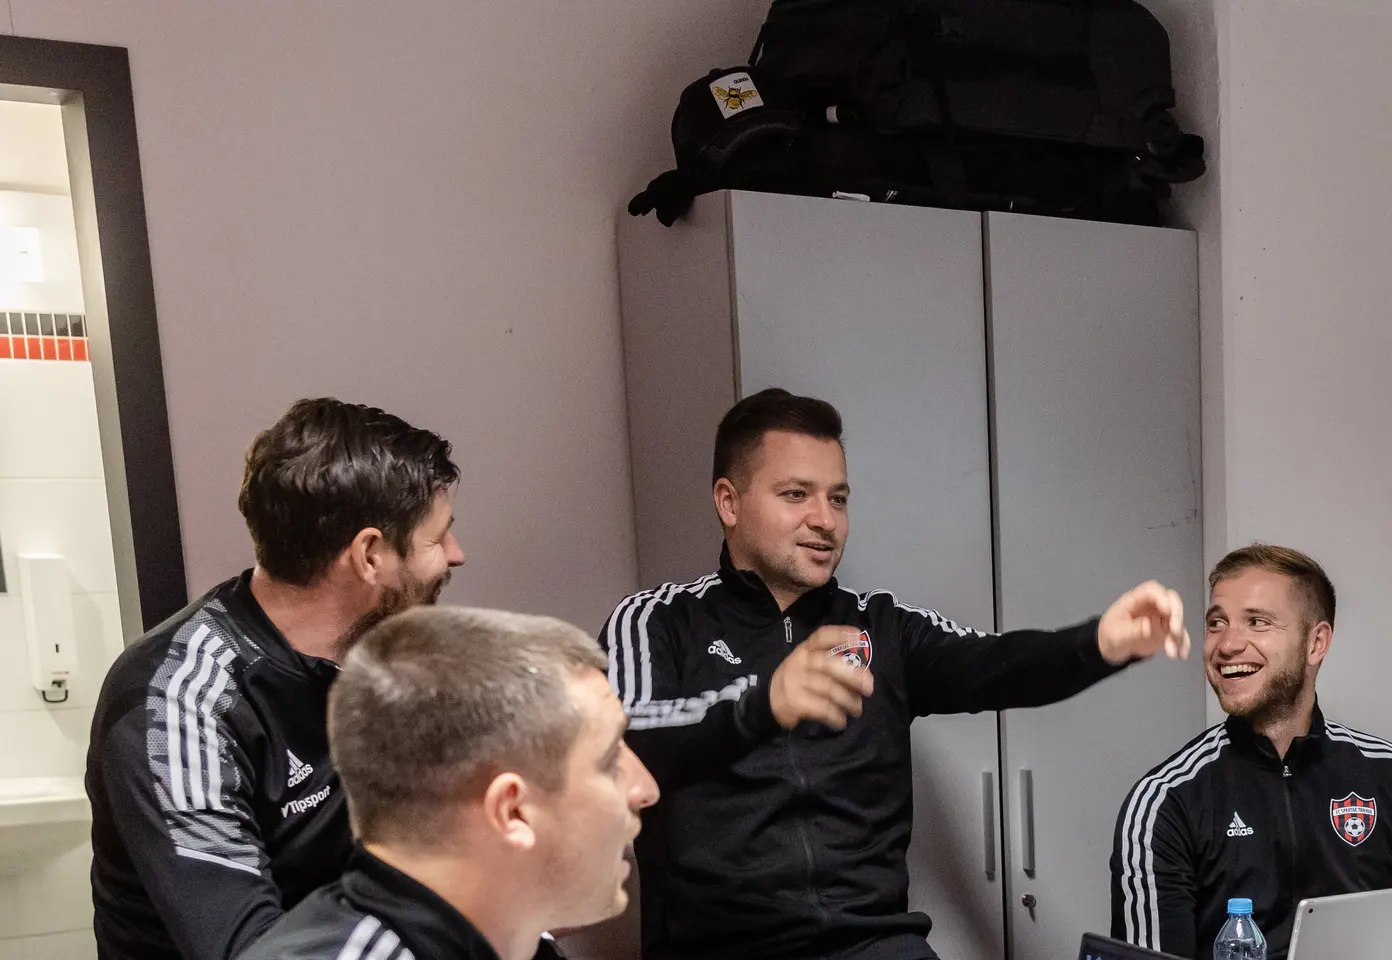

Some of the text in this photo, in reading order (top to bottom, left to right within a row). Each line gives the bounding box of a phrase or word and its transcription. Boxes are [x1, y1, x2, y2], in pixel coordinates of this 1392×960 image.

[708, 645, 742, 665] adidas
[287, 764, 313, 788] adidas
[287, 785, 331, 814] Tipsport
[1226, 826, 1254, 837] adidas
